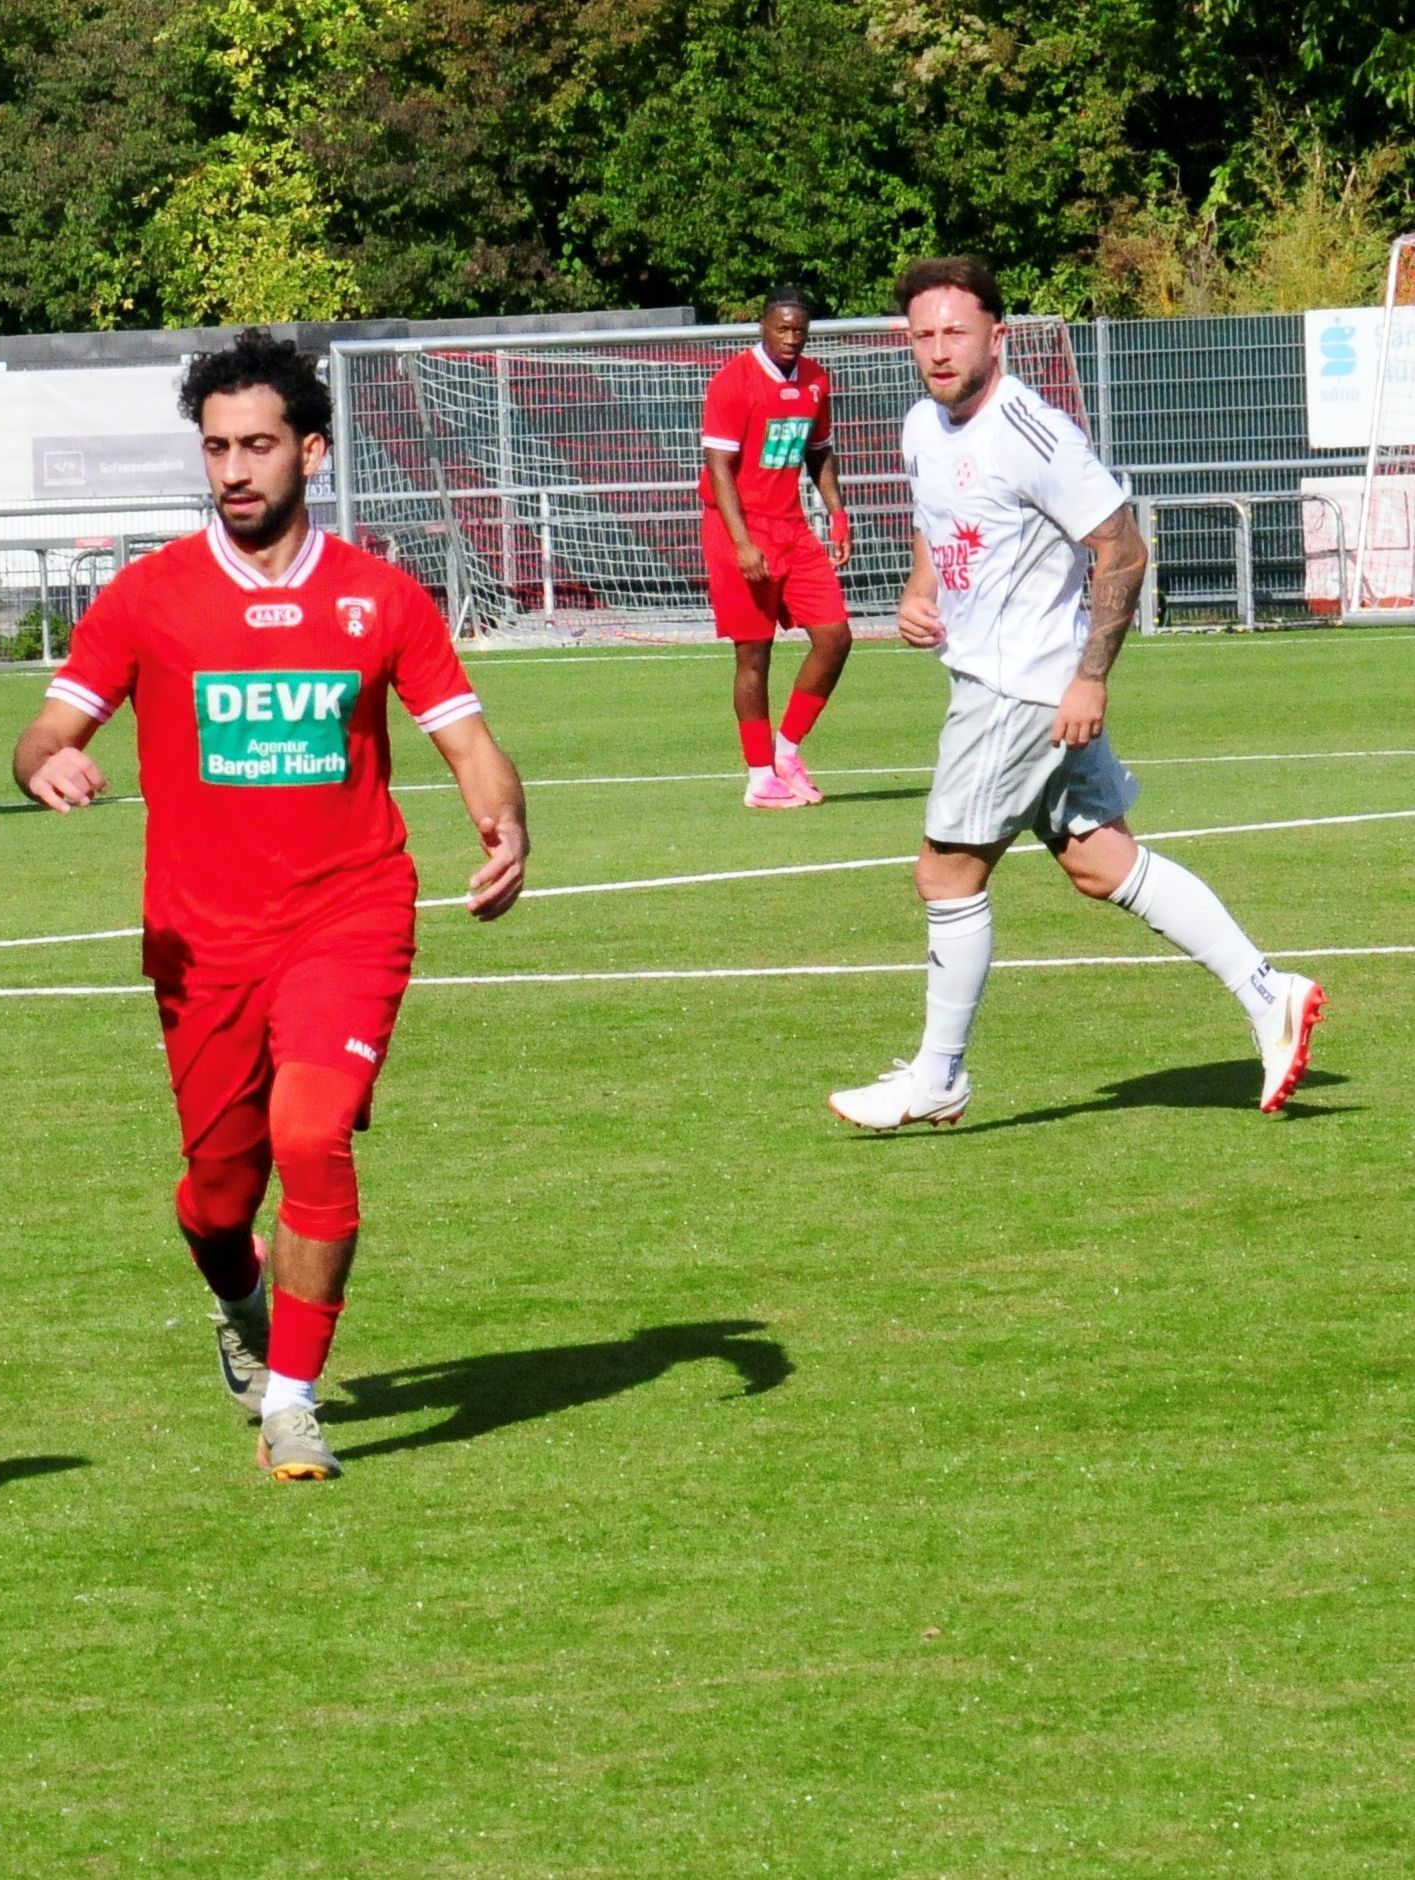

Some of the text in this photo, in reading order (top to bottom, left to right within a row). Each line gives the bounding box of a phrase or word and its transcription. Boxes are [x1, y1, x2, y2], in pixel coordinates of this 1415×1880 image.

[941, 566, 971, 591] RKS
[206, 682, 347, 723] DEVK
[247, 738, 309, 757] Agentur
[208, 752, 346, 779] Bargel Hürth
